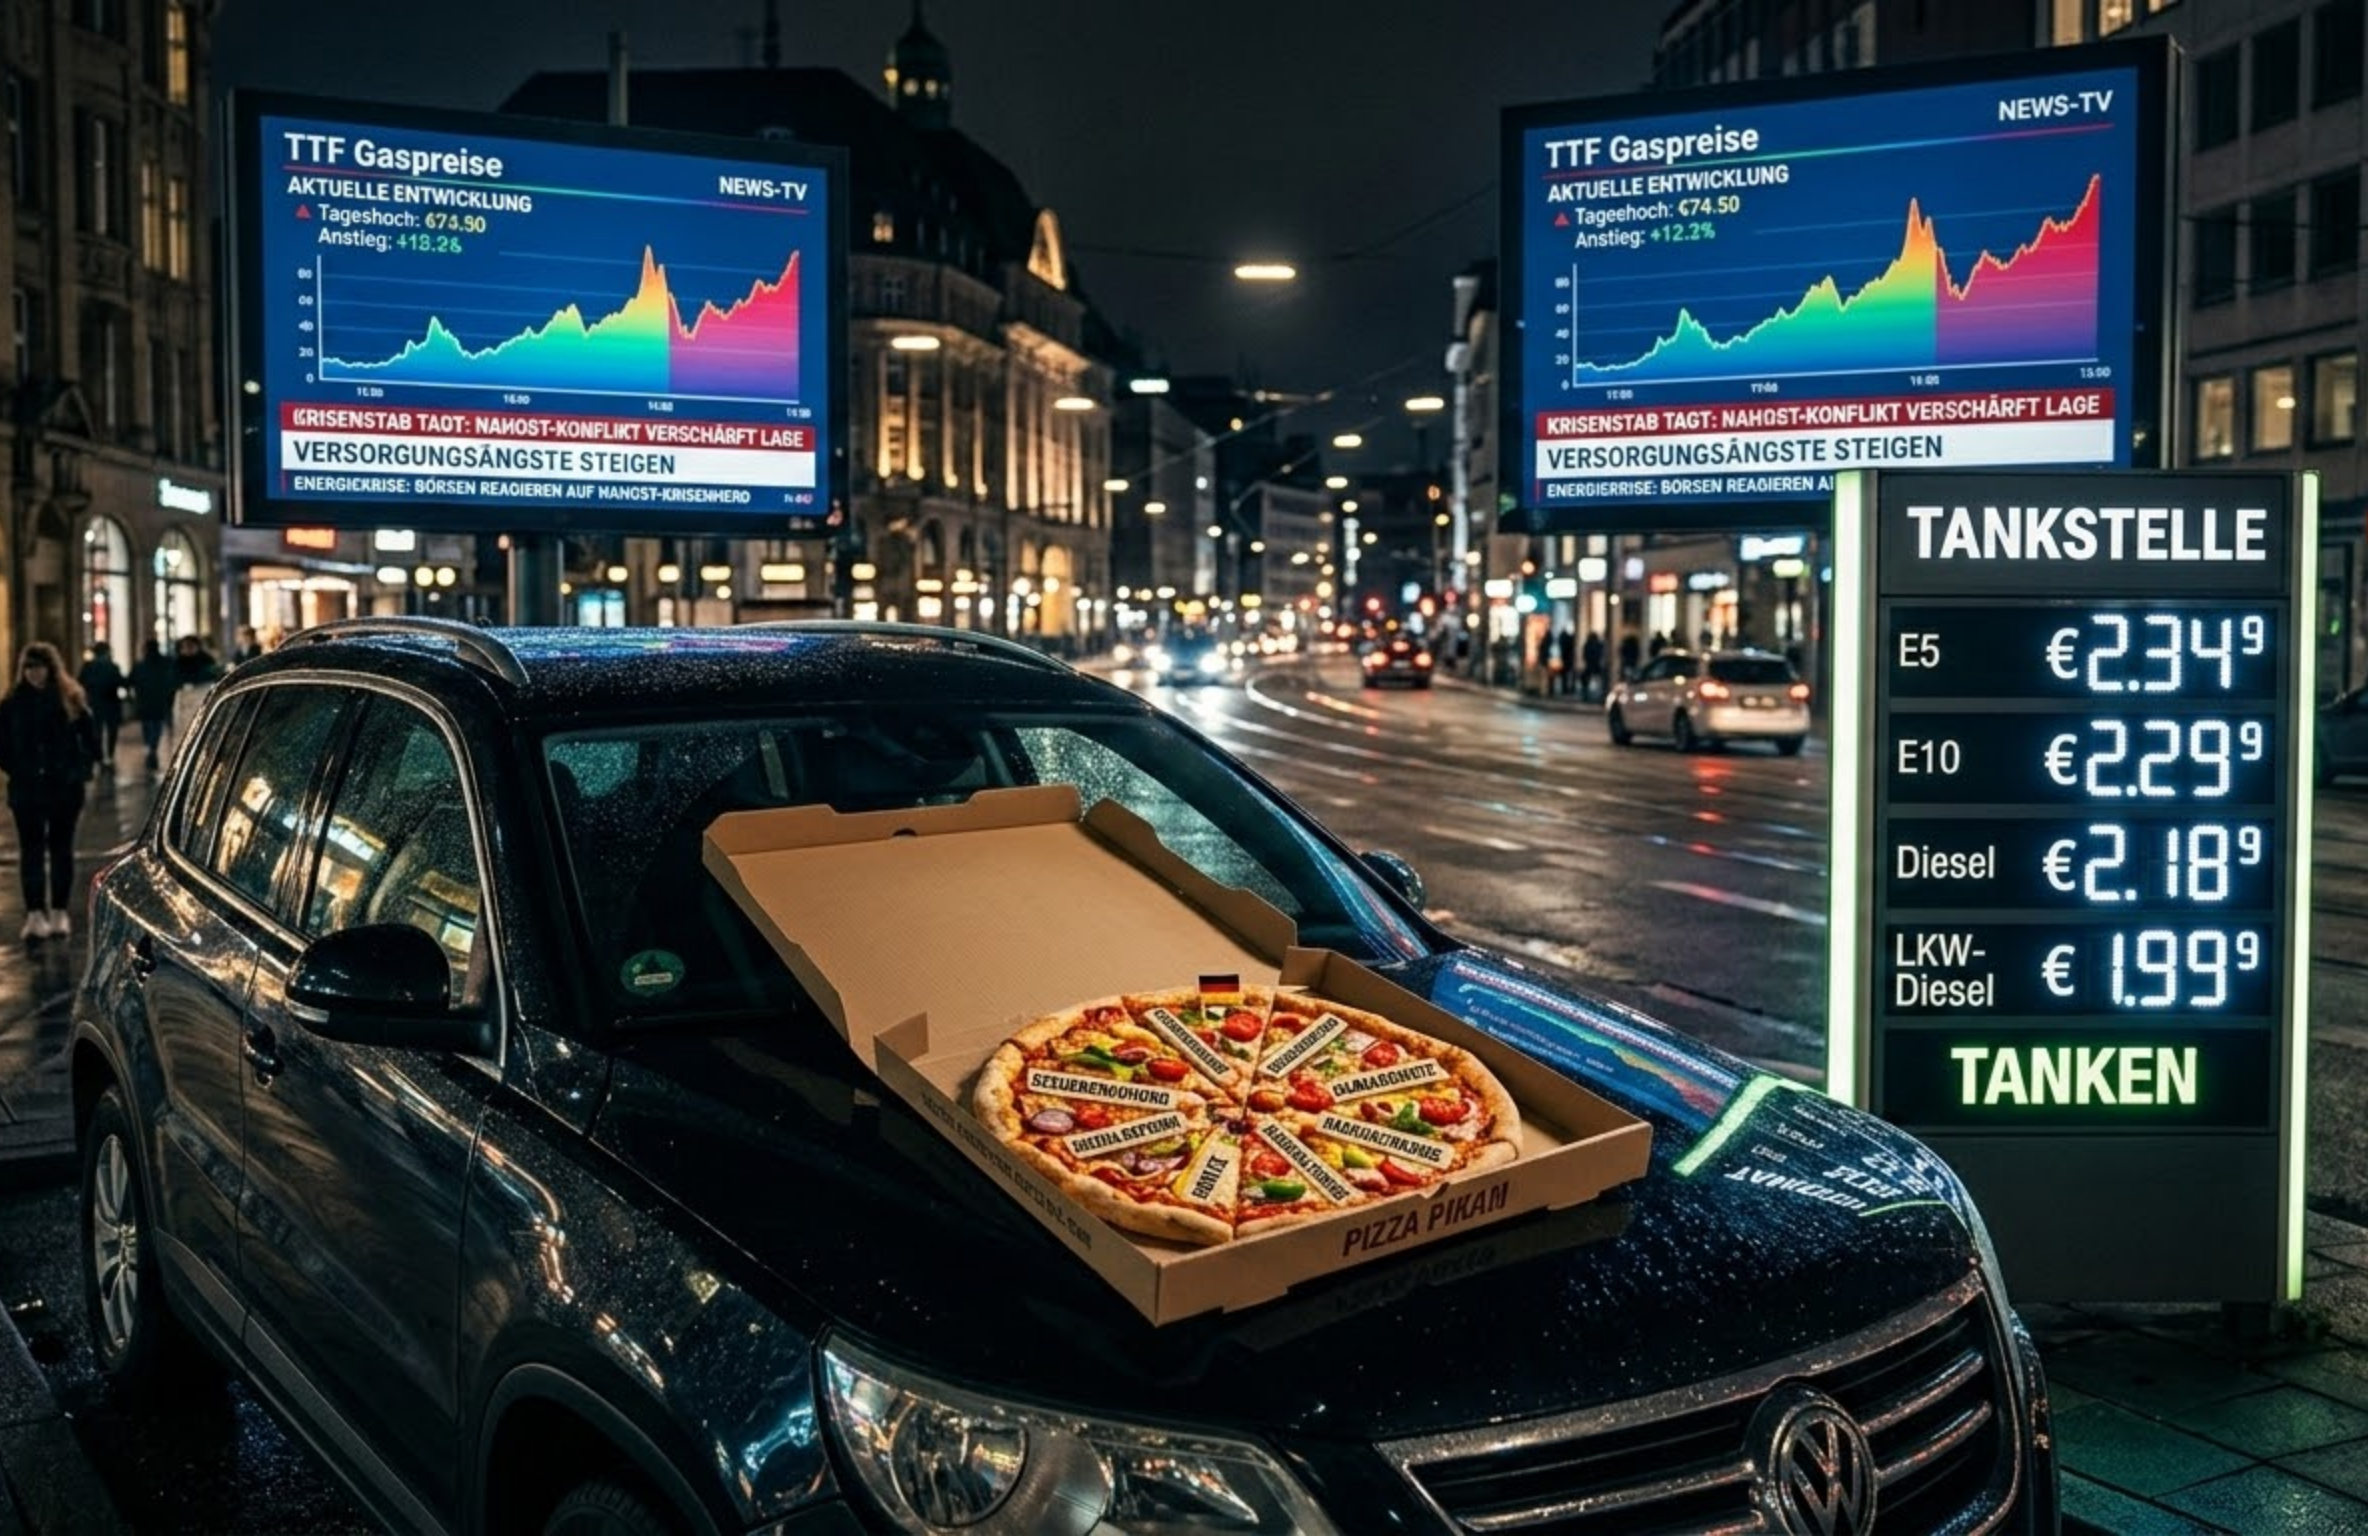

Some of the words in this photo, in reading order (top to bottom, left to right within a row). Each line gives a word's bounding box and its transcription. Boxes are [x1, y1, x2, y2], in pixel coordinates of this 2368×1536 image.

[1999, 90, 2113, 121] NEWS-TV
[284, 132, 346, 163] TTF
[354, 139, 503, 178] Gaspreise
[1545, 137, 1602, 168] TTF
[1610, 124, 1759, 165] Gaspreise
[287, 176, 390, 202] AKTUELLE
[394, 183, 532, 213] ENTWICKLUNG
[719, 176, 807, 202] NEWS-TV
[1547, 177, 1644, 203] AKTUELLE
[318, 204, 421, 228] Tageshoch:
[318, 228, 392, 252] Anstieg:
[1575, 229, 1646, 250] Anstieg:
[1547, 412, 1659, 435] KRISENSTAB
[1663, 410, 1717, 431] TAGT:
[2045, 395, 2100, 417] LAGE
[579, 452, 676, 475] STEIGEN
[1834, 435, 1943, 461] STEIGEN
[565, 484, 595, 499] AUF
[1907, 506, 2266, 560] TANKSTELLE
[1900, 633, 1940, 668] E5
[1898, 740, 1960, 774] E10
[1897, 845, 1995, 879] Diesel
[1896, 933, 1986, 967] LKW-
[1896, 973, 1994, 1007] Diesel
[1951, 1047, 2197, 1105] TANKEN
[1342, 1210, 1418, 1257] PIZZA
[1428, 1181, 1510, 1232] PIKAN
